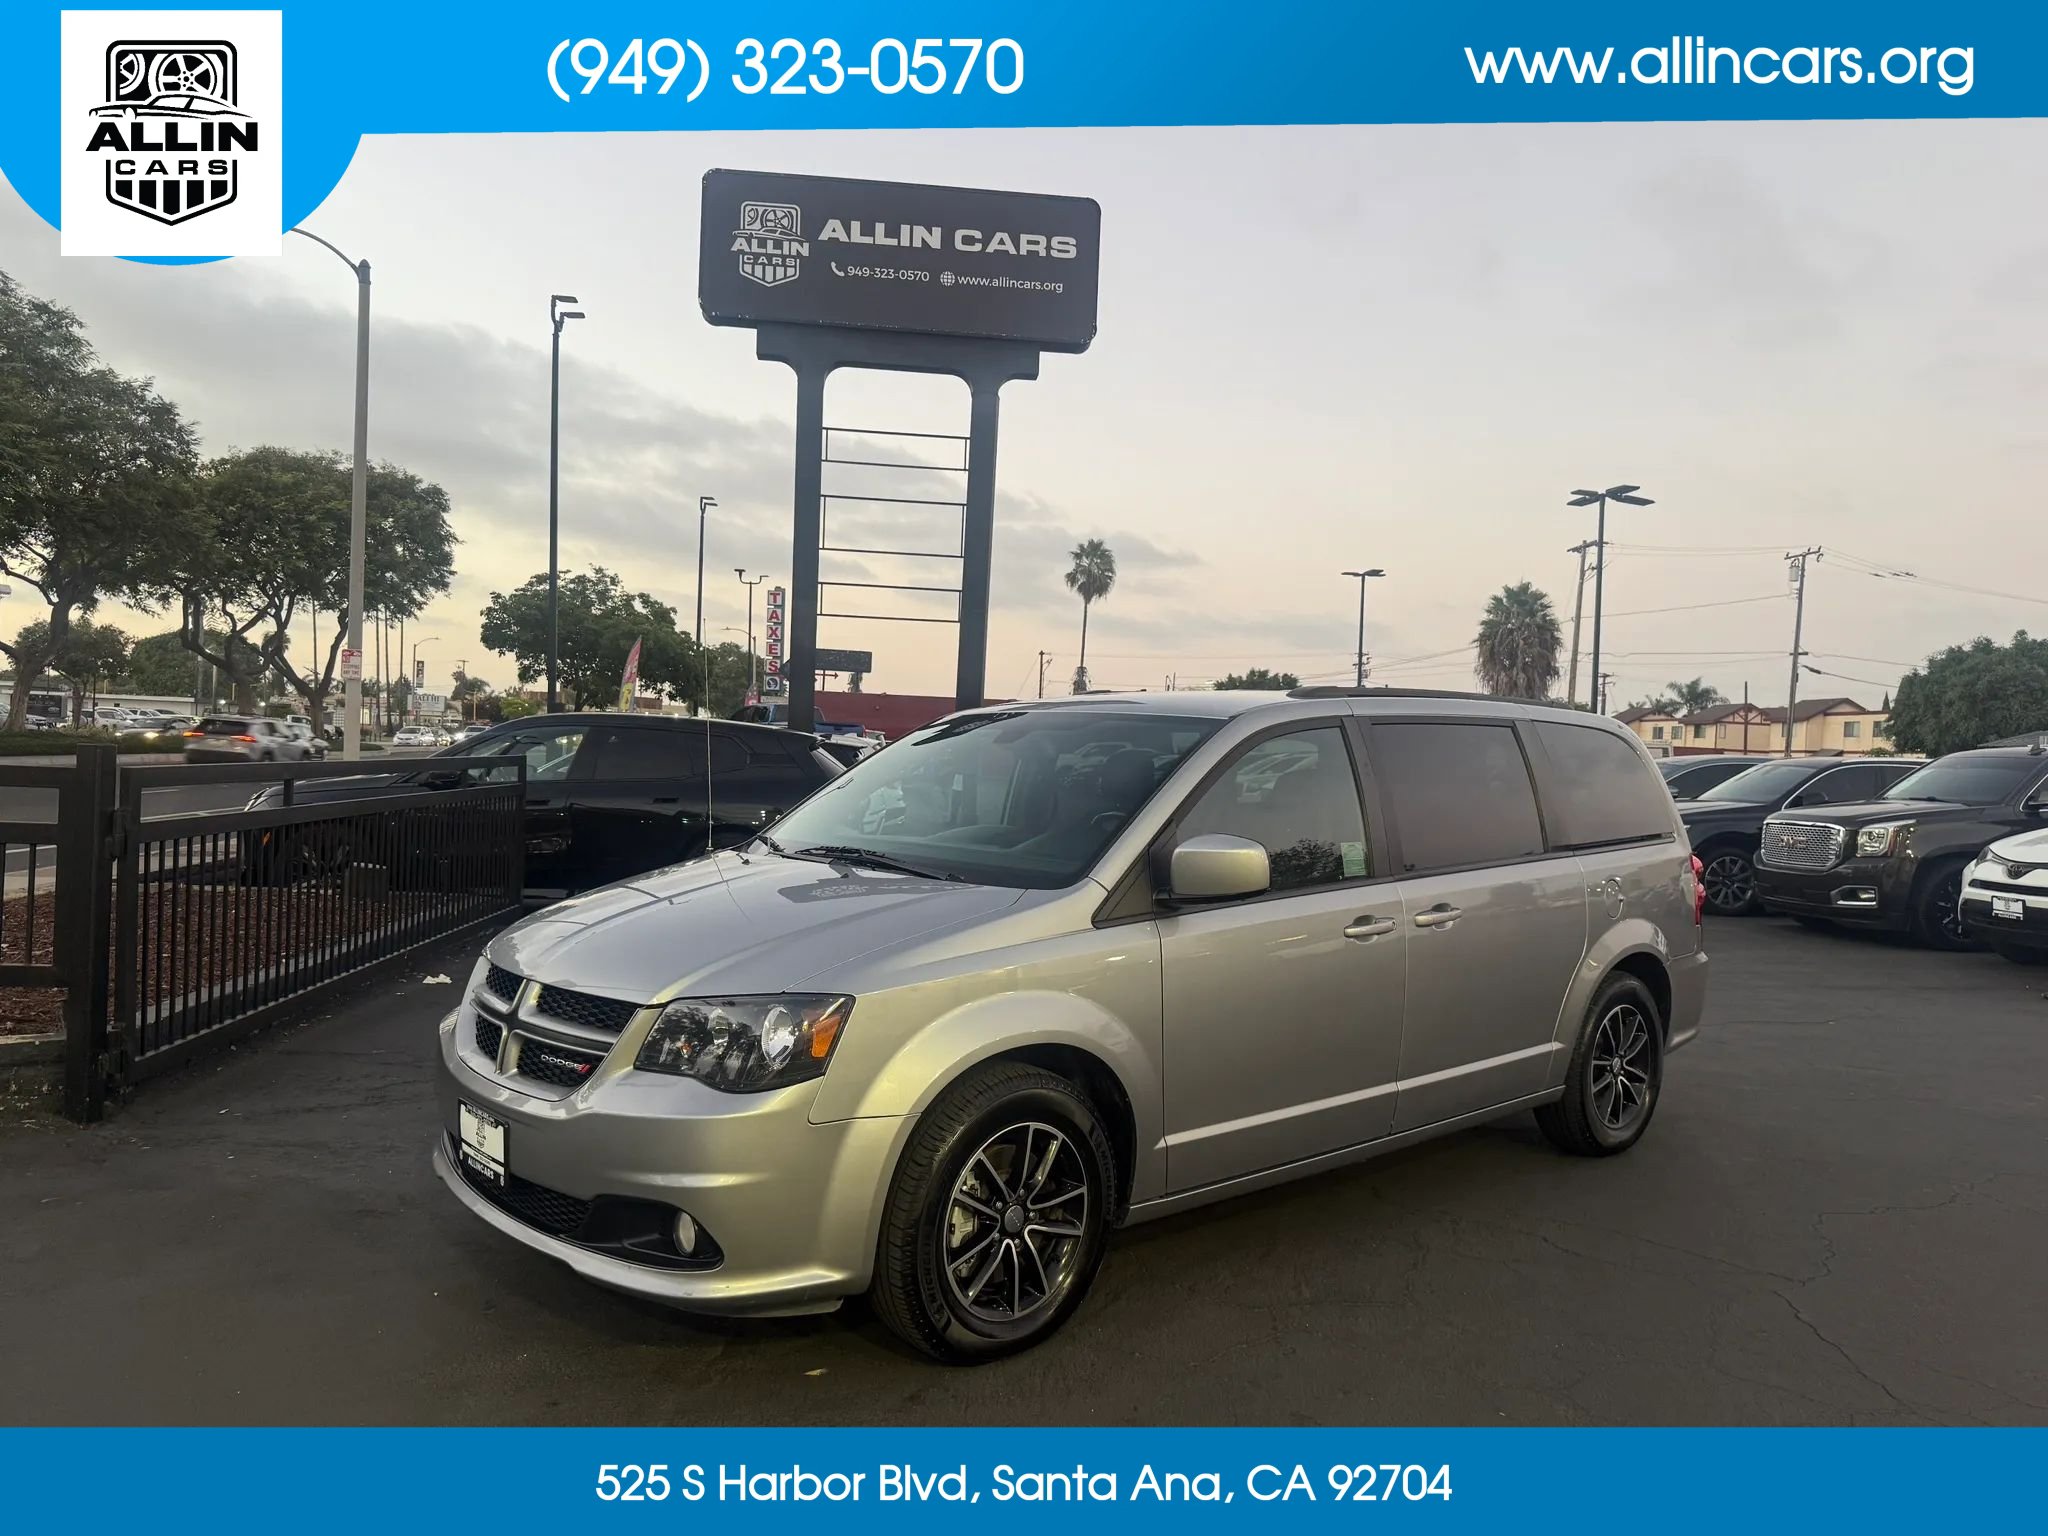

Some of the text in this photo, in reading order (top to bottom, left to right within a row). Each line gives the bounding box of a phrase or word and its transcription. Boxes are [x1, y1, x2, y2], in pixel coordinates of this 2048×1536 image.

[730, 237, 810, 257] ALLIN
[817, 218, 1078, 259] ALLIN CARS
[743, 254, 796, 266] CARS
[847, 265, 930, 282] 949-323-0570
[957, 275, 1064, 294] www.allincars.org
[767, 592, 781, 674] TAXES
[541, 1054, 583, 1071] DODGE
